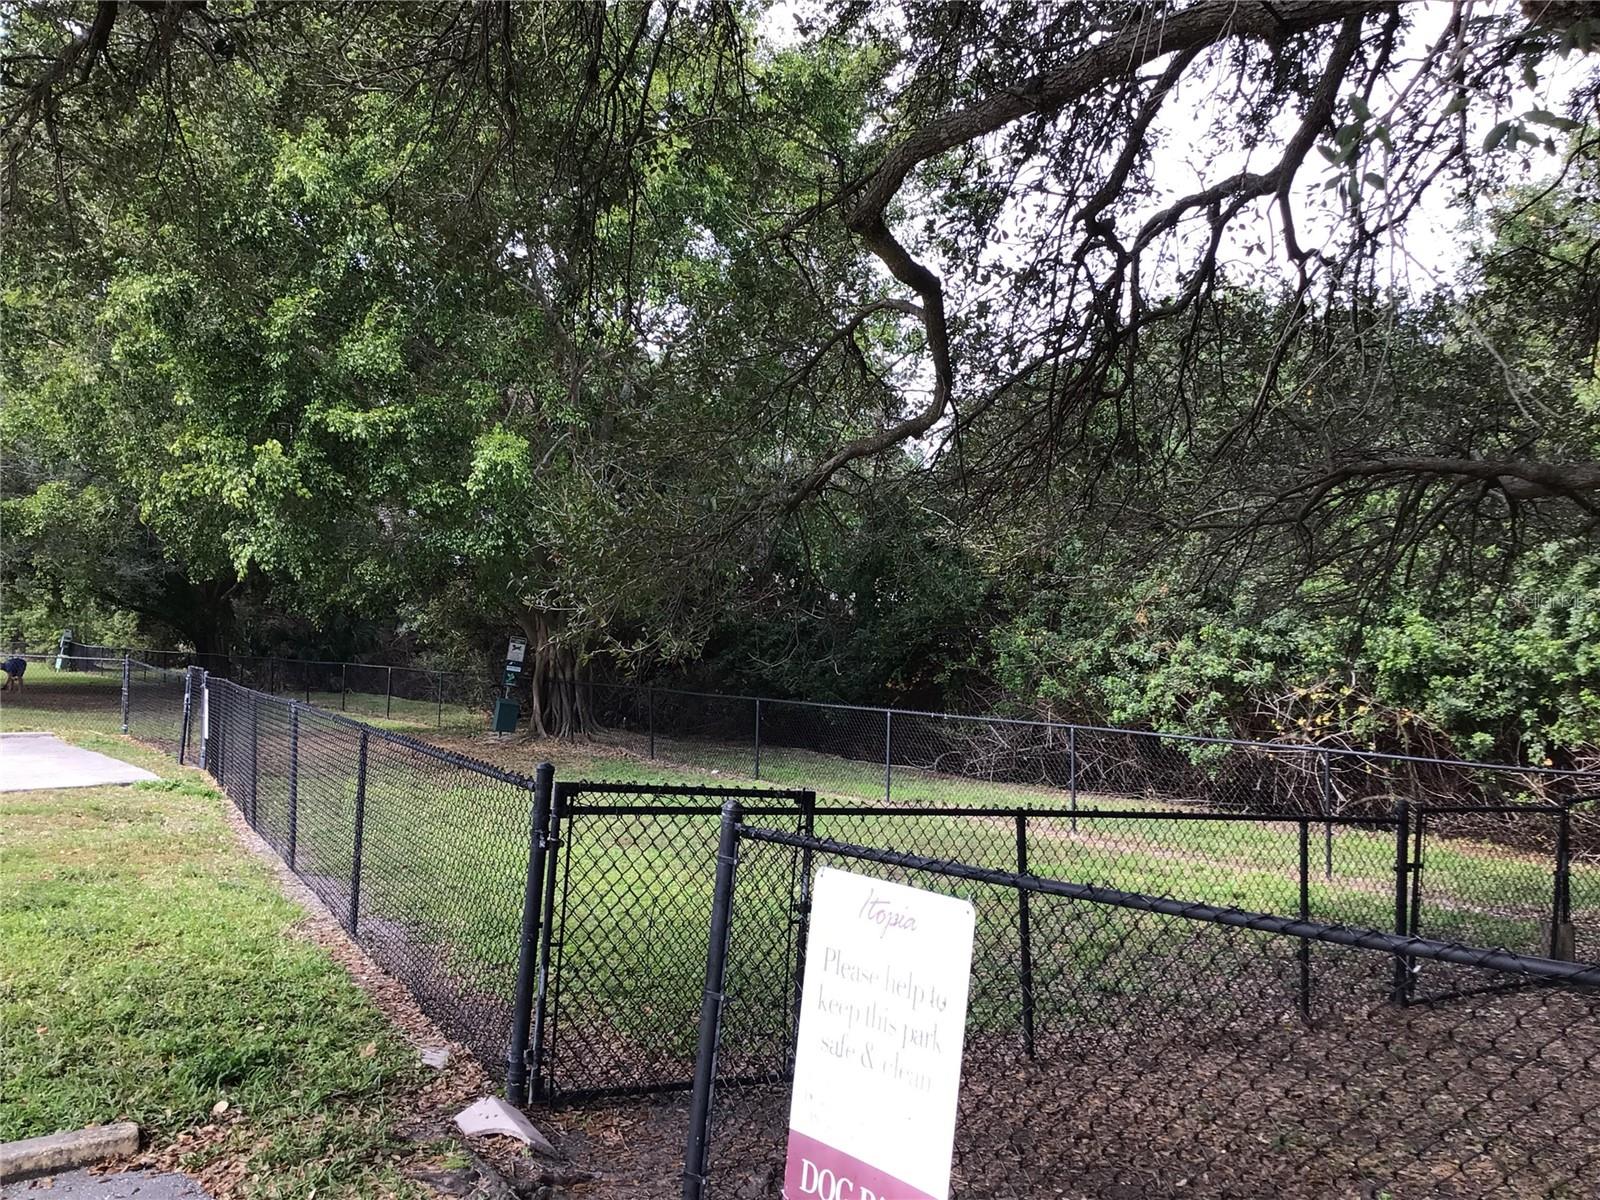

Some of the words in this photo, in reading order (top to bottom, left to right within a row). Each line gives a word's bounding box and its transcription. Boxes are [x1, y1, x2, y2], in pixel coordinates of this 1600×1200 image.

[858, 888, 918, 939] Itopia
[824, 946, 880, 985] Please
[885, 965, 925, 1011] help
[930, 986, 948, 1012] to
[817, 984, 861, 1029] keep
[865, 1001, 897, 1035] this
[902, 1023, 942, 1054] park
[820, 1034, 856, 1058] safe
[860, 1041, 875, 1070] &
[882, 1052, 932, 1092] clean
